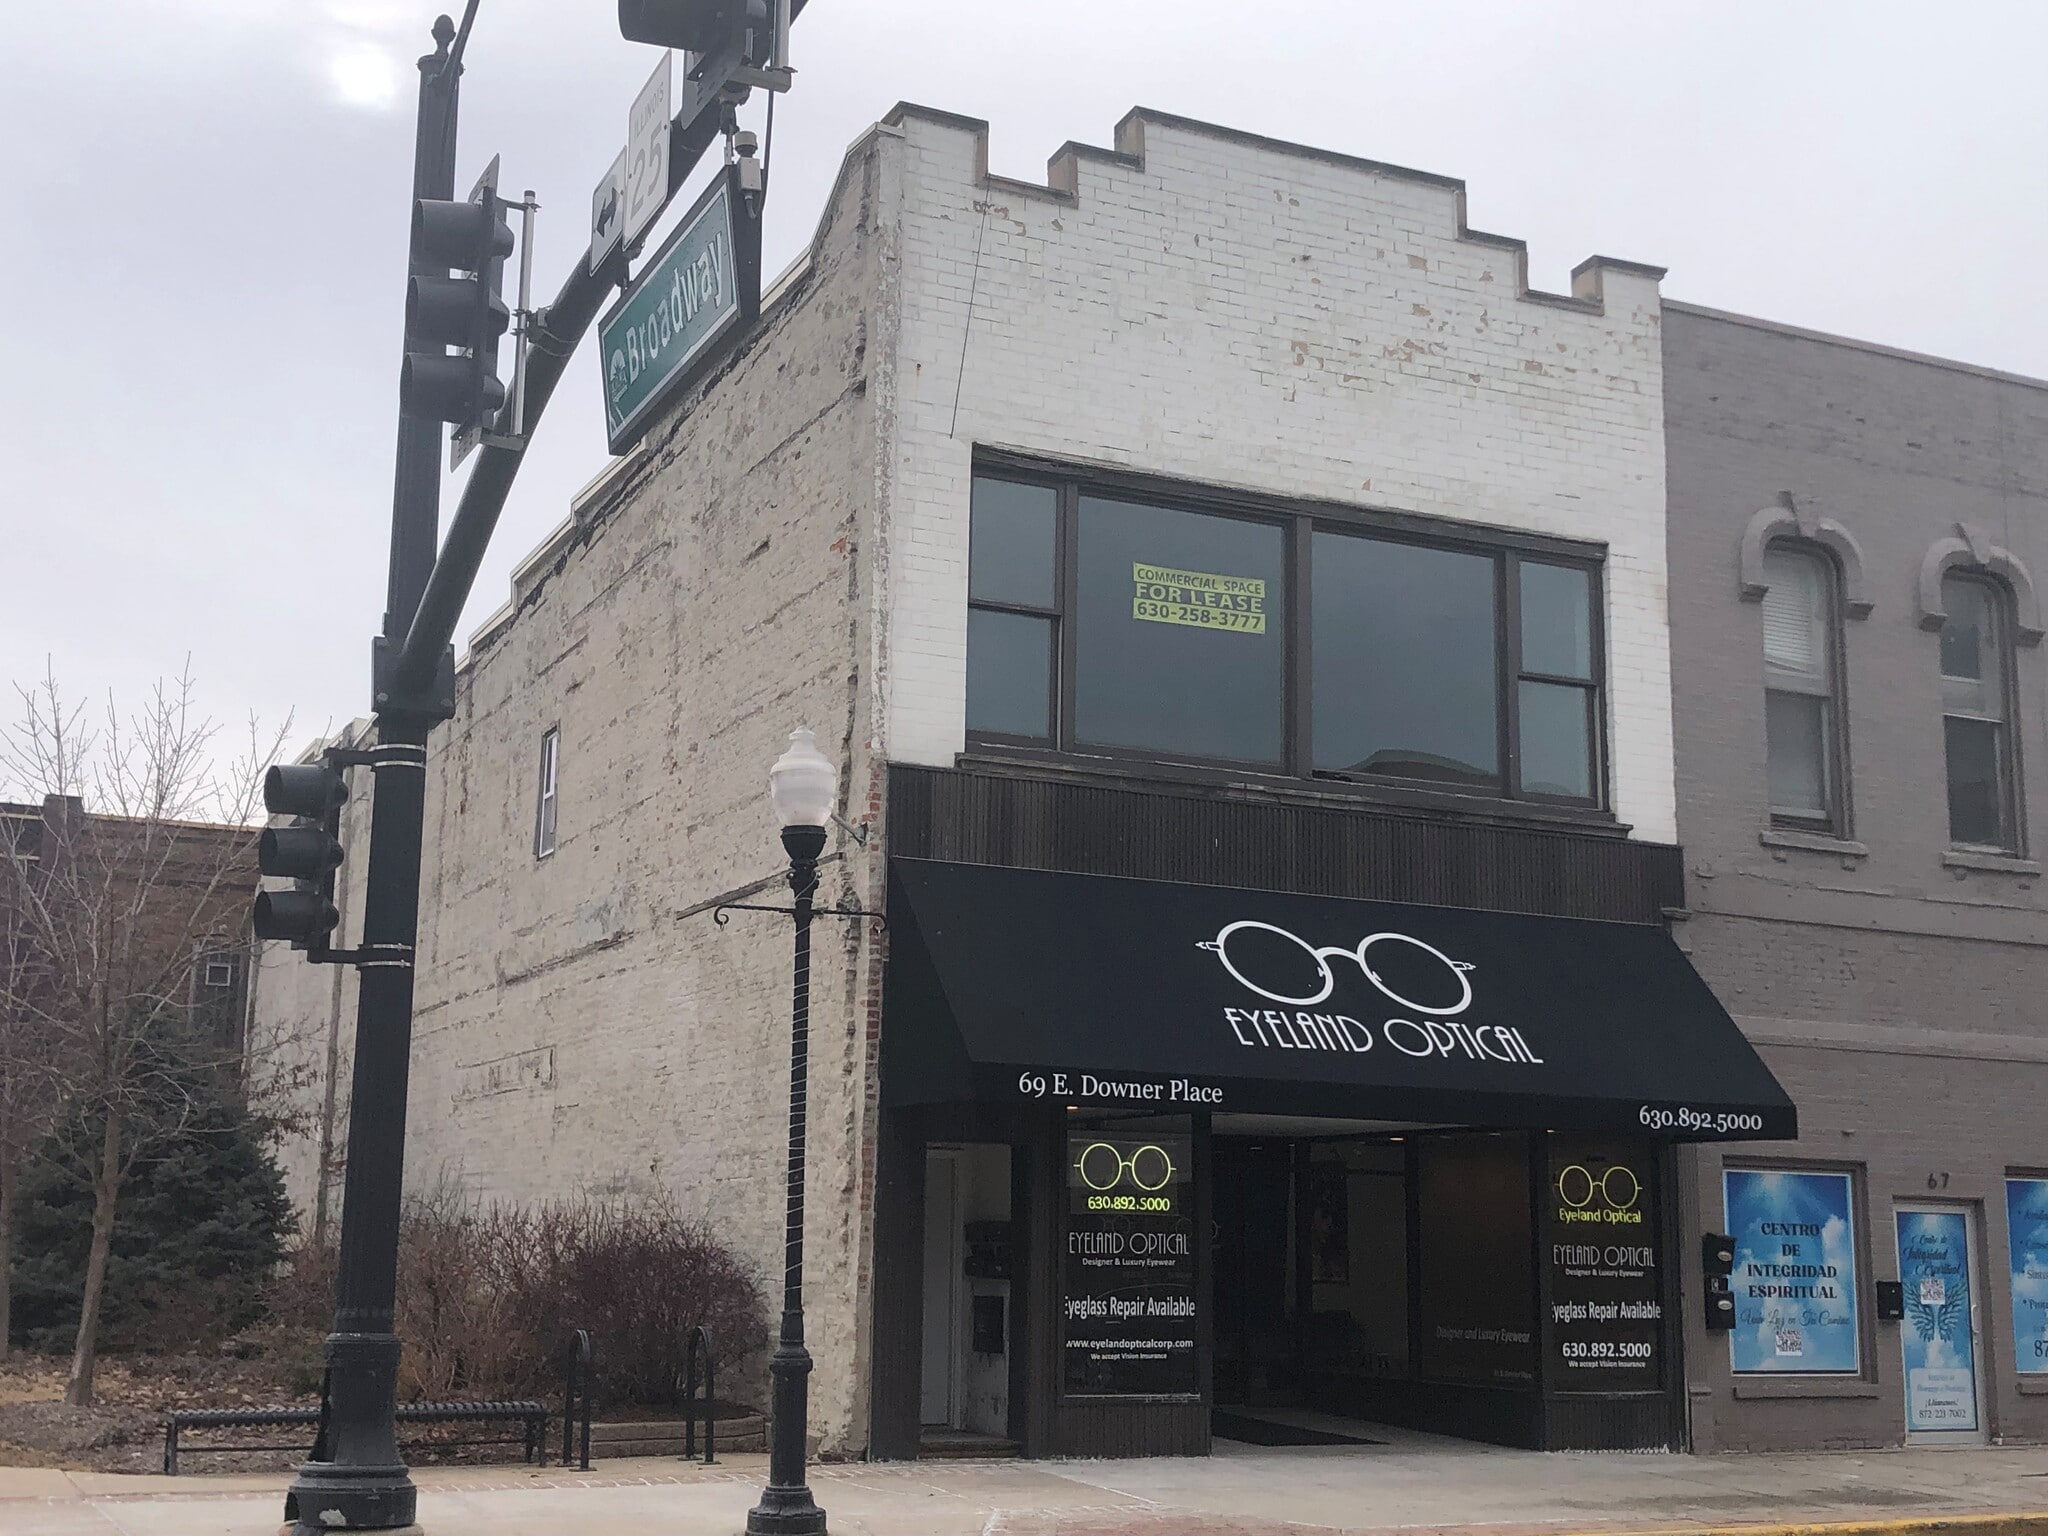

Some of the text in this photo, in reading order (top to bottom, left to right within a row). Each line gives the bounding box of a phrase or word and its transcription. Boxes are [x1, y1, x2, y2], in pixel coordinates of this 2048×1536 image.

[633, 81, 664, 139] ILLINOIS
[630, 120, 662, 221] 25
[626, 230, 723, 385] Broadway
[1137, 568, 1262, 595] COMMERCIAL SPACE
[1136, 582, 1263, 613] FOR LEASE
[1137, 602, 1262, 629] 630-258-3777
[1223, 1007, 1544, 1063] EYELAND OPTICAL
[1019, 1072, 1223, 1103] 69 E. Downer Place
[1640, 1105, 1762, 1132] 630.892.5000
[1928, 1172, 1949, 1190] 67
[1088, 1196, 1170, 1211] 630.892.5000
[1559, 1208, 1642, 1225] Eyeland Optical
[1761, 1222, 1820, 1236] CENTRO
[1068, 1232, 1189, 1255] EYELAND OPTICAL
[1781, 1243, 1800, 1256] DE
[1082, 1257, 1113, 1267] Designer
[1122, 1258, 1145, 1267] Luxury
[1146, 1258, 1176, 1268] Eyewear
[1553, 1244, 1655, 1267] EYELAND OPTICAL
[1747, 1264, 1837, 1278] INTEGRIDAD
[1748, 1285, 1837, 1299] ESPIRITUAL
[1109, 1296, 1145, 1320] Repair
[1147, 1296, 1196, 1317] Available
[1588, 1301, 1618, 1323] Repair
[1620, 1301, 1661, 1319] Available
[1562, 1342, 1651, 1358] 630.892.5000
